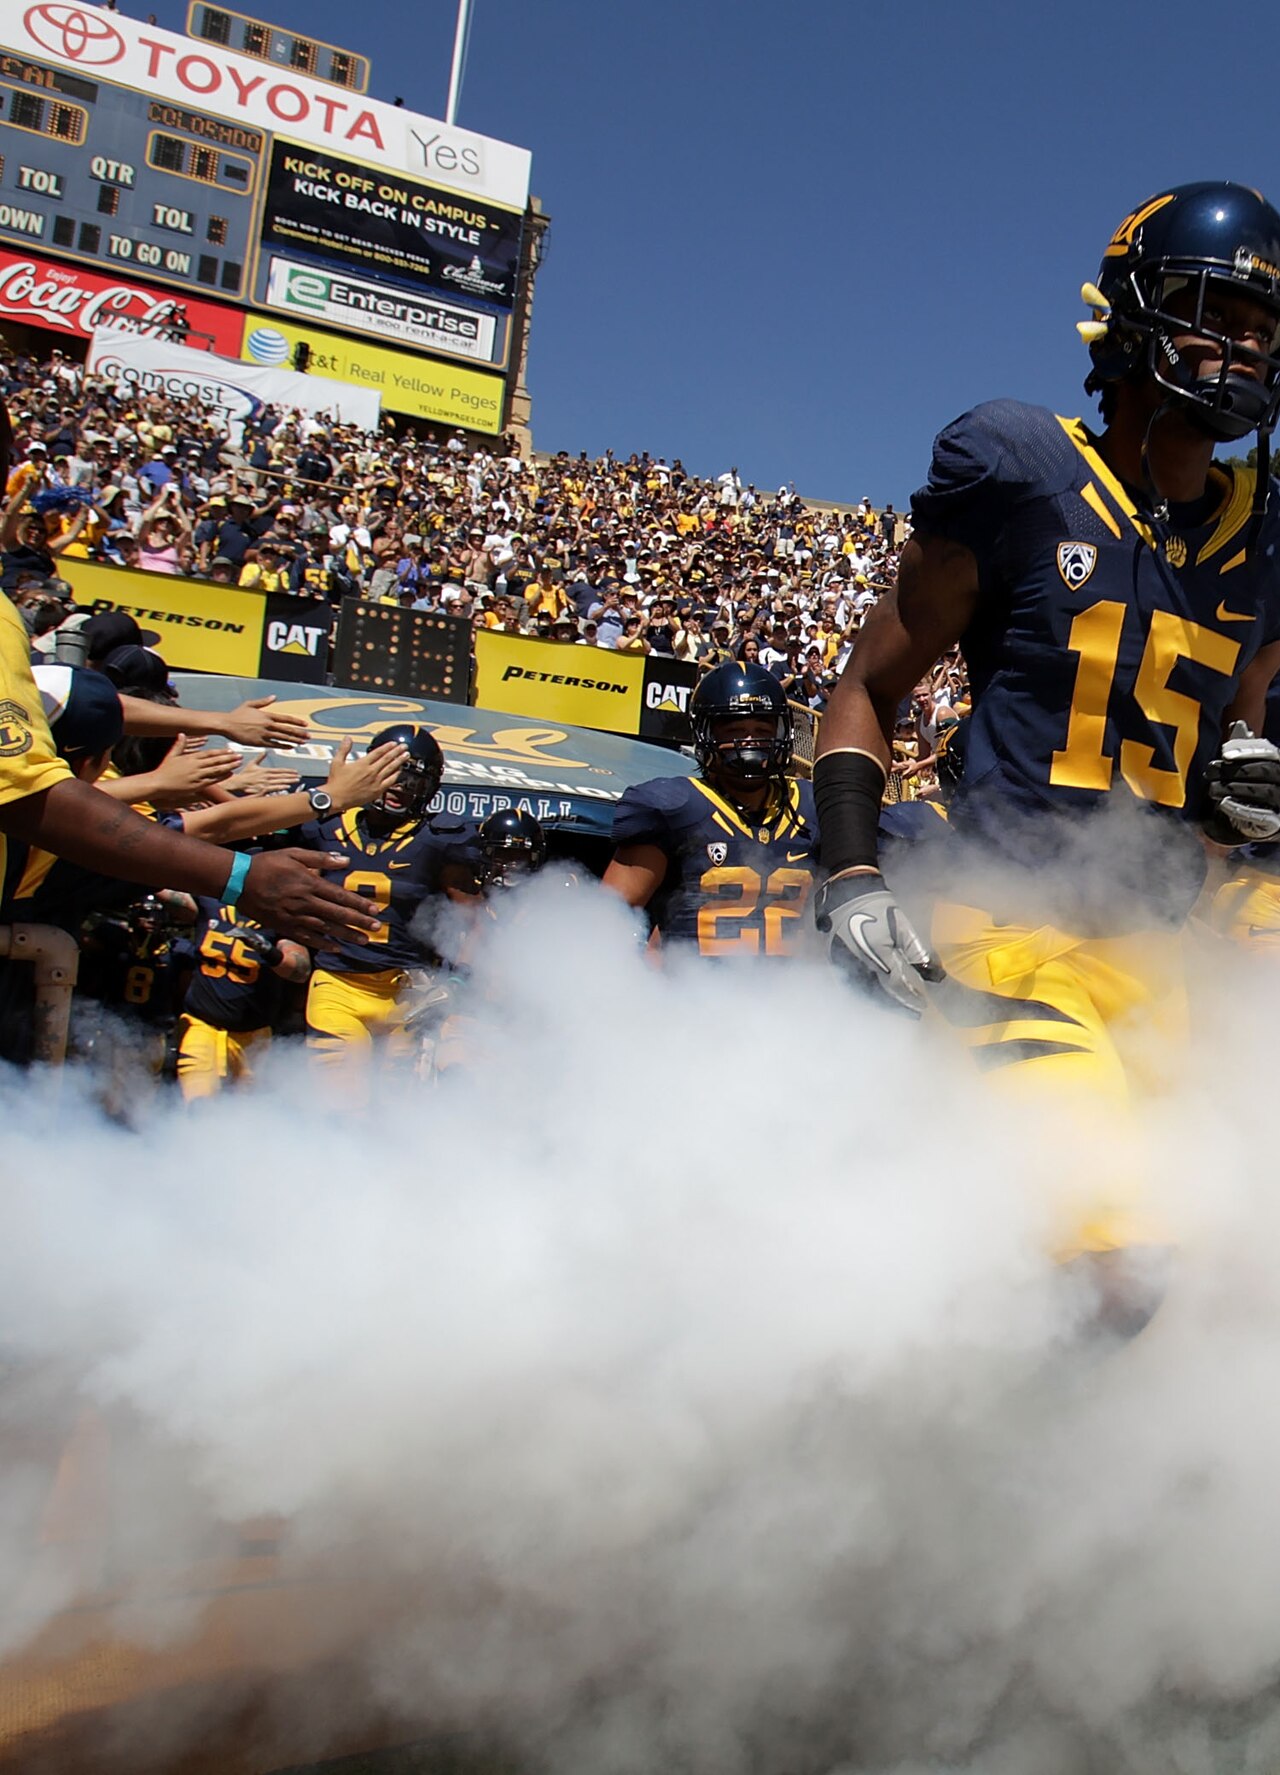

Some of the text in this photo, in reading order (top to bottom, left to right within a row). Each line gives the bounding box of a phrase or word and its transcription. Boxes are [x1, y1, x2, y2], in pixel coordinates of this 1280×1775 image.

[1, 57, 62, 92] CAL
[138, 37, 385, 150] TOYOTA
[91, 156, 134, 184] QTR
[410, 129, 480, 176] Yes
[20, 166, 61, 195] TOL
[284, 157, 332, 182] KICK
[335, 172, 374, 194] OFF
[379, 185, 408, 204] ON
[413, 195, 486, 229] CAMPUS
[0, 205, 44, 234] OWN
[154, 203, 193, 233] TOL
[294, 178, 480, 245] KICK BACK IN STYLE
[110, 235, 190, 273] TO GO ON
[330, 283, 477, 337] Enterprise
[406, 326, 474, 348] rent-a-car
[105, 363, 226, 404] comcast
[308, 349, 498, 411] t&t Real Yellow Pages
[1066, 561, 1086, 580] 10
[267, 621, 322, 656] CAT
[502, 666, 629, 694] PETERSON
[646, 682, 690, 712] CAT
[1049, 600, 1242, 808] 15
[426, 790, 577, 823] OOTBALL
[697, 866, 814, 957] 22
[200, 929, 261, 985] 55
[126, 966, 155, 1003] 8
